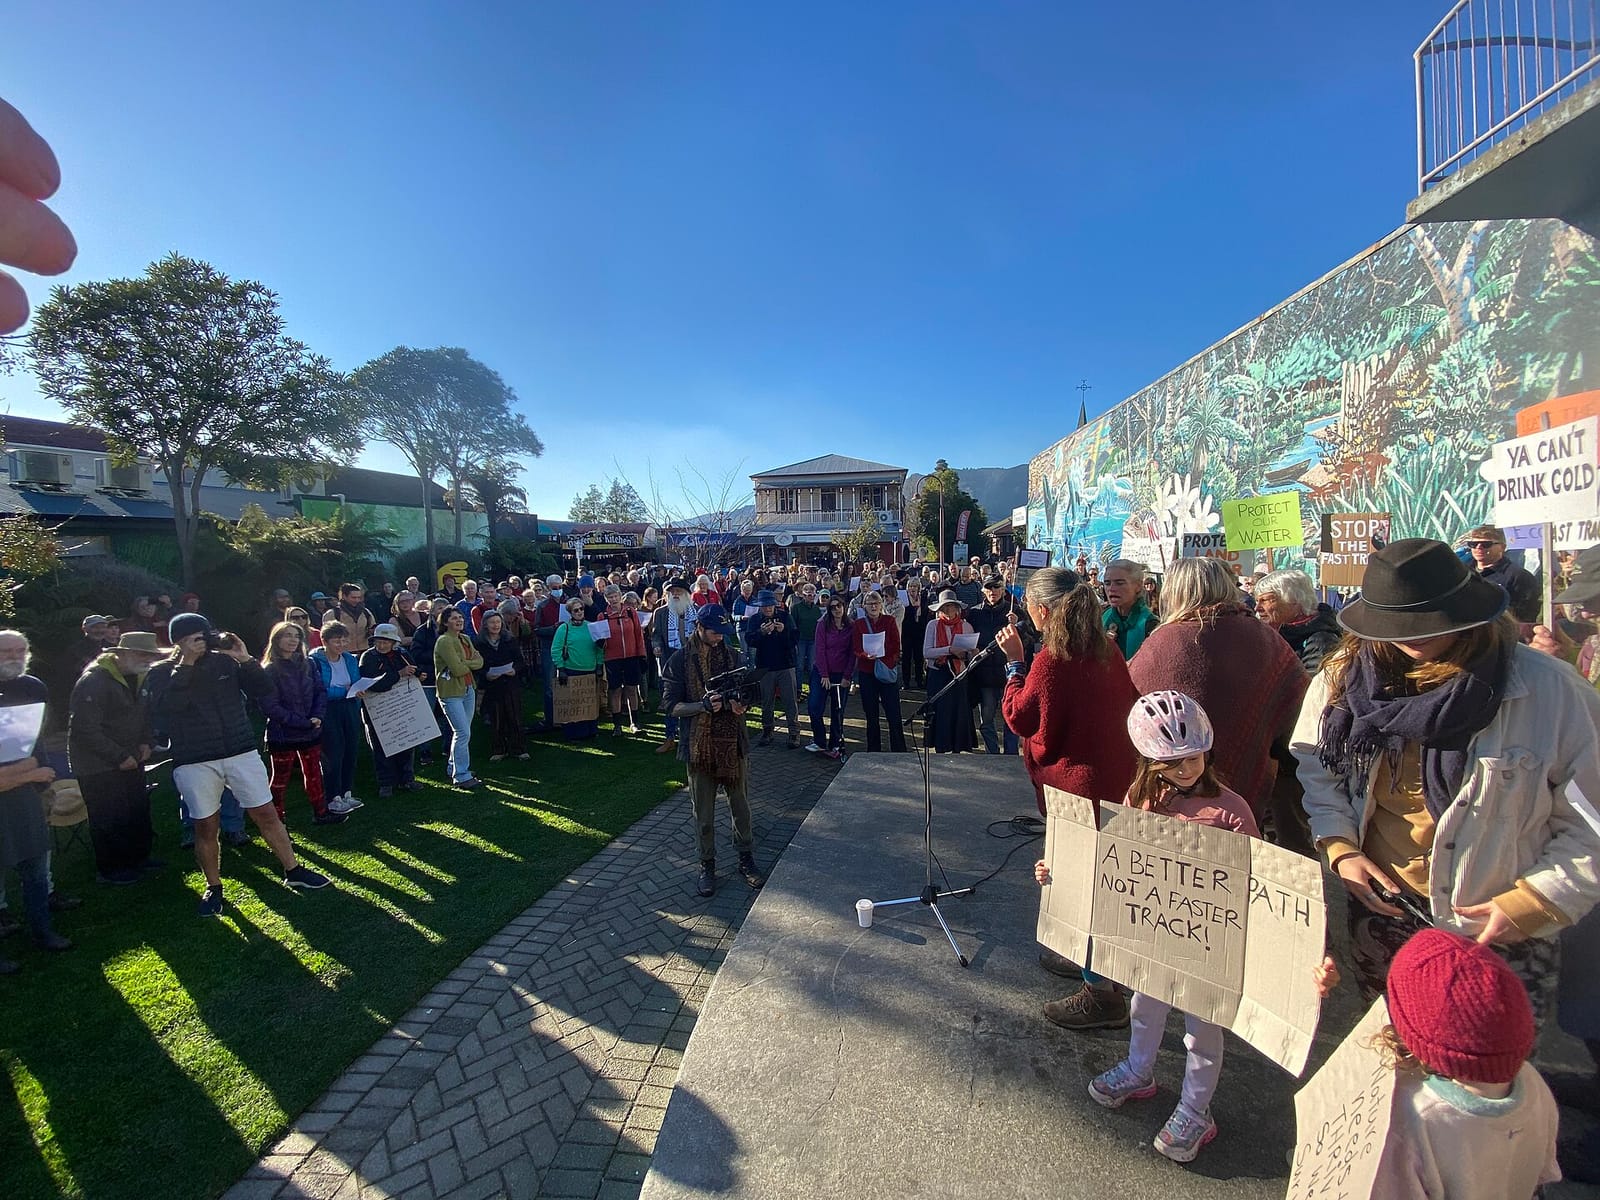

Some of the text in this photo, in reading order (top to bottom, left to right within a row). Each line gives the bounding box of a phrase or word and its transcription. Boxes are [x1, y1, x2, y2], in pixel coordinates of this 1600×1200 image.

[1507, 424, 1586, 469] YA CAN'T
[1498, 463, 1595, 502] DRINK GOLD
[1238, 501, 1291, 518] PROTECT
[1252, 518, 1278, 527] OUR
[1330, 520, 1379, 538] STOP
[1552, 520, 1600, 543] AST TRA
[604, 533, 632, 547] Kitchen
[1183, 534, 1227, 548] PROTE
[1238, 529, 1292, 545] WATER
[1196, 549, 1240, 562] LAND
[1338, 541, 1367, 552] THE
[1321, 553, 1351, 565] FAST
[1102, 843, 1310, 927] A BETTER PATH
[1101, 872, 1242, 930] NOT A FASTER
[1125, 902, 1212, 952] TRACK!
[1338, 1090, 1365, 1187] needs
[1291, 1143, 1311, 1193] Sur
